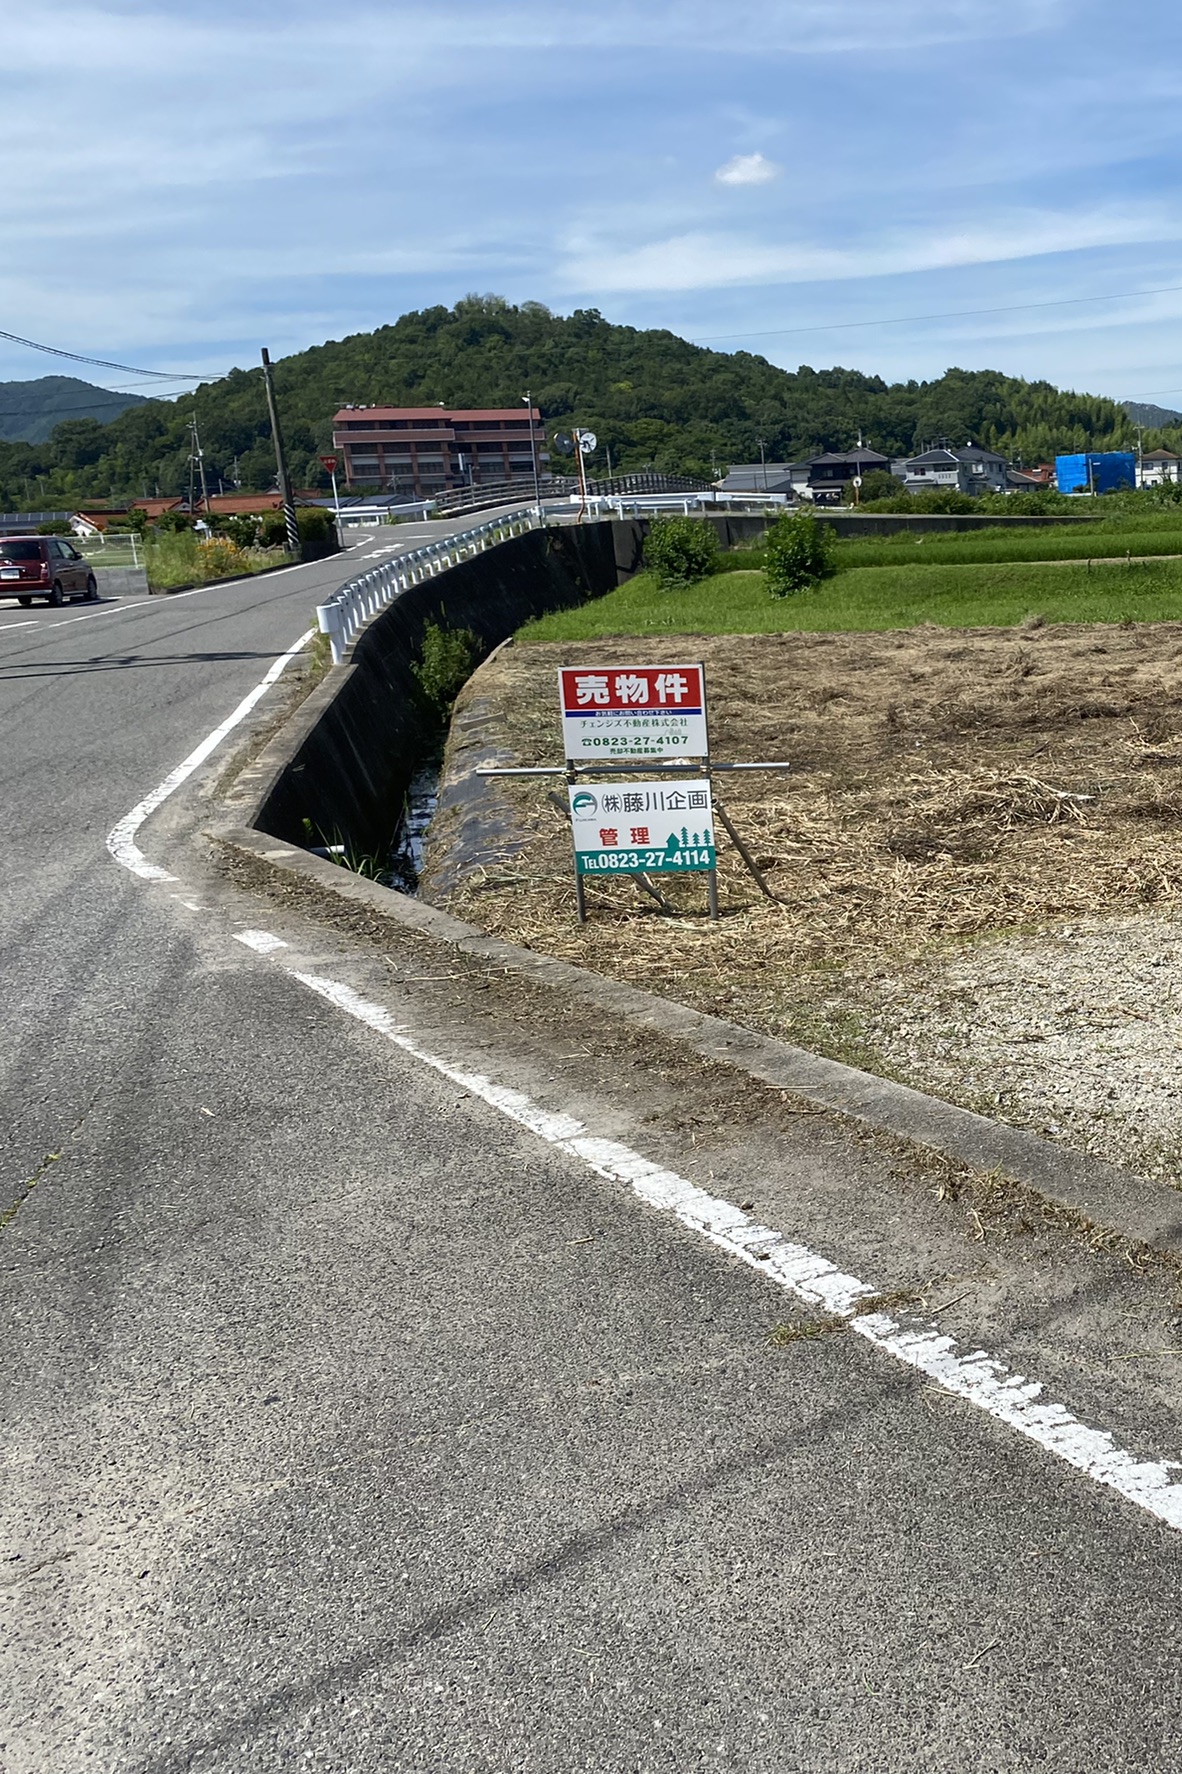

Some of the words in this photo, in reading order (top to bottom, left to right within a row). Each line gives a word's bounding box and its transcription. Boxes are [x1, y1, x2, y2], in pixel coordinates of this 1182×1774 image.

[574, 673, 689, 705] 売物件
[580, 718, 688, 728] チェンジズ不動産株式会社
[599, 827, 650, 846] 管理
